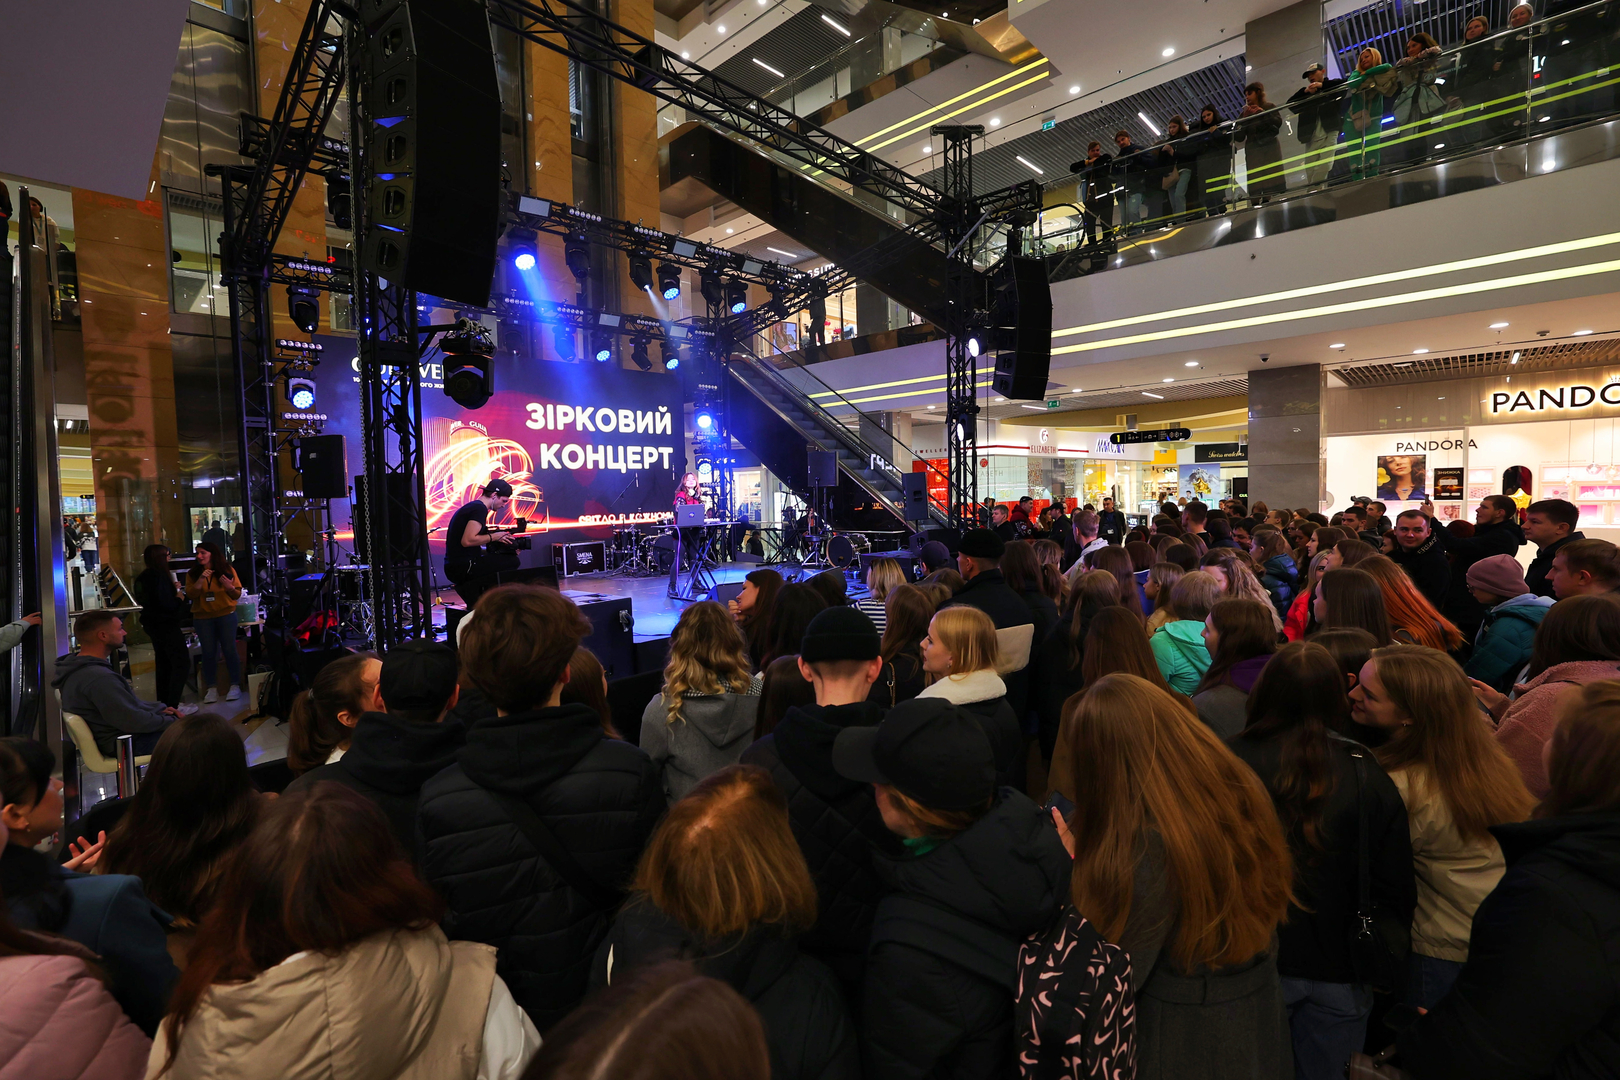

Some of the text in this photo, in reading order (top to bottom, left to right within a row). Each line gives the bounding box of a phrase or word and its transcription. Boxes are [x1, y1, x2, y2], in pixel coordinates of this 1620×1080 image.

[525, 402, 672, 435] ЗІРКОВИЙ
[1031, 445, 1057, 453] ELIZABETH
[1396, 439, 1478, 452] PANDORA
[540, 443, 674, 474] КОНЦЕРТ
[578, 514, 616, 522] СВІТЛО
